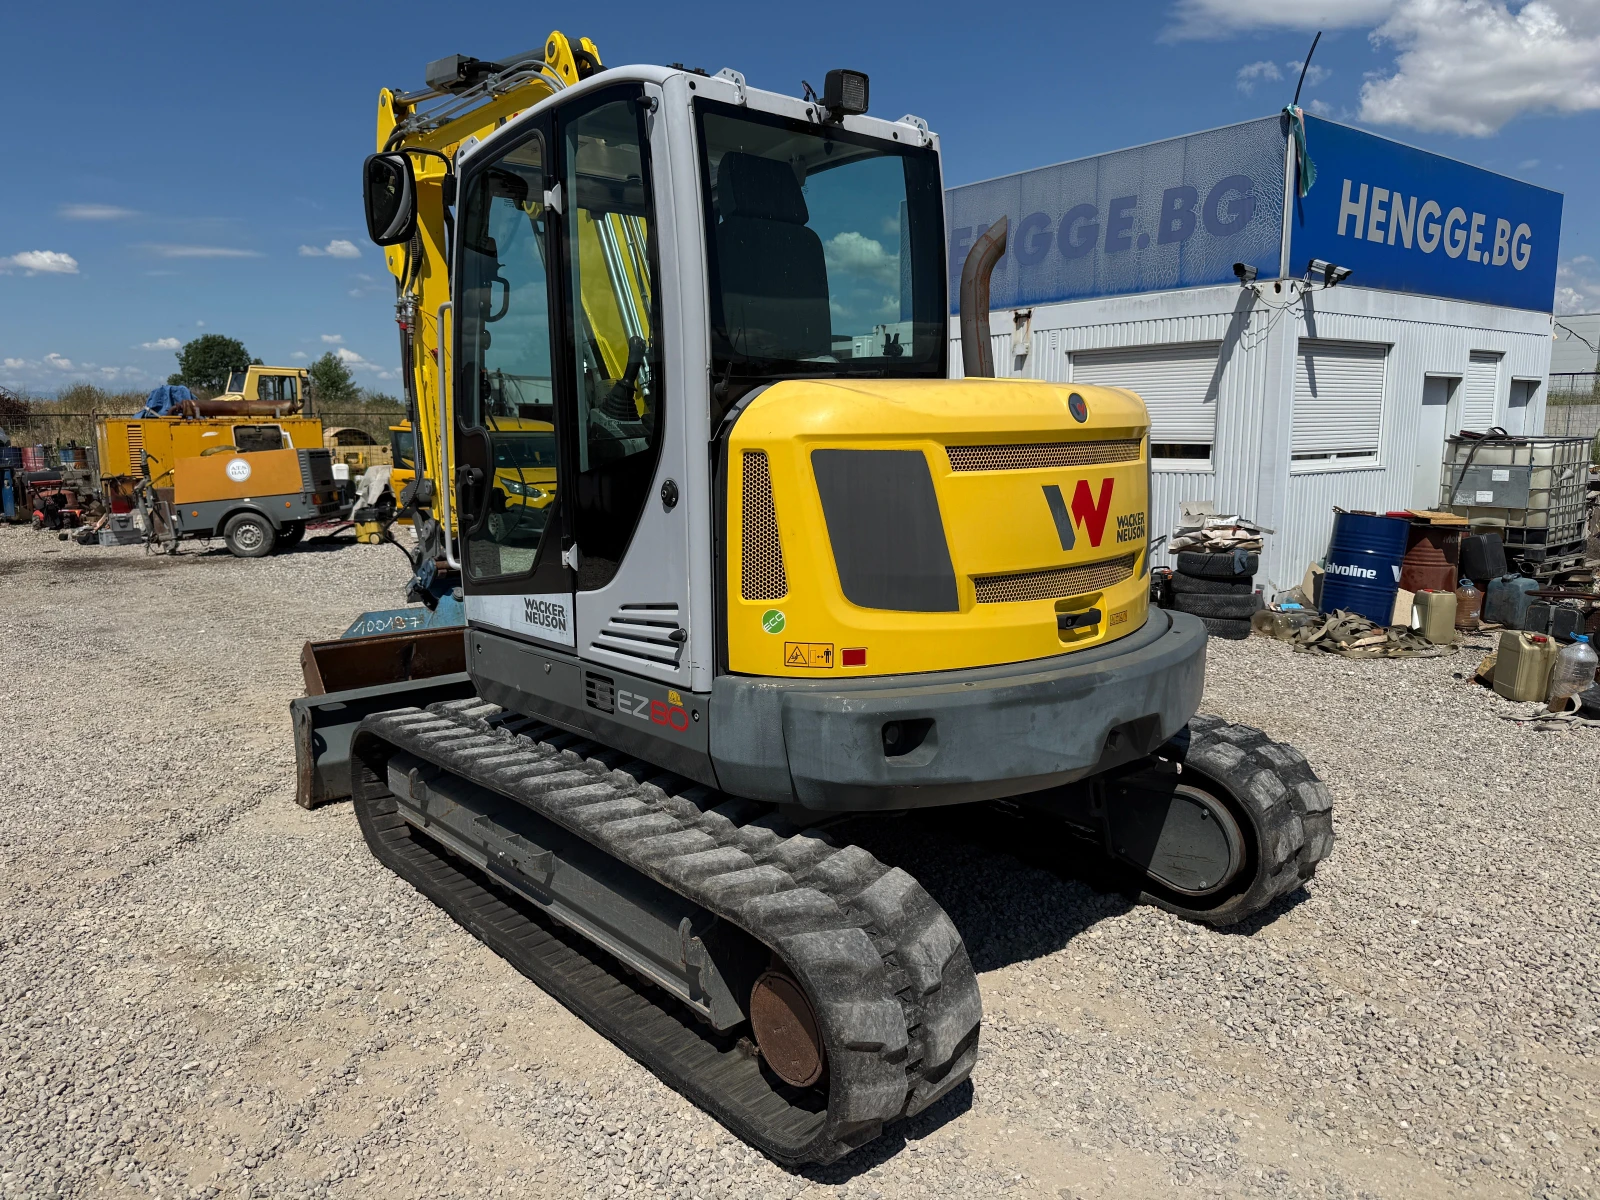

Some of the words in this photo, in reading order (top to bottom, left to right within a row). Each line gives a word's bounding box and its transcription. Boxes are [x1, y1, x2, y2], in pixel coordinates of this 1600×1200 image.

[1337, 178, 1532, 271] HENGGE.BG
[1116, 511, 1145, 529] WACKER
[1116, 525, 1145, 543] NEUSON
[1325, 561, 1376, 580] alvoline
[524, 597, 565, 618] WACKER
[525, 610, 566, 631] NEUSON
[763, 611, 785, 632] ECO
[617, 689, 689, 733] EZ80
